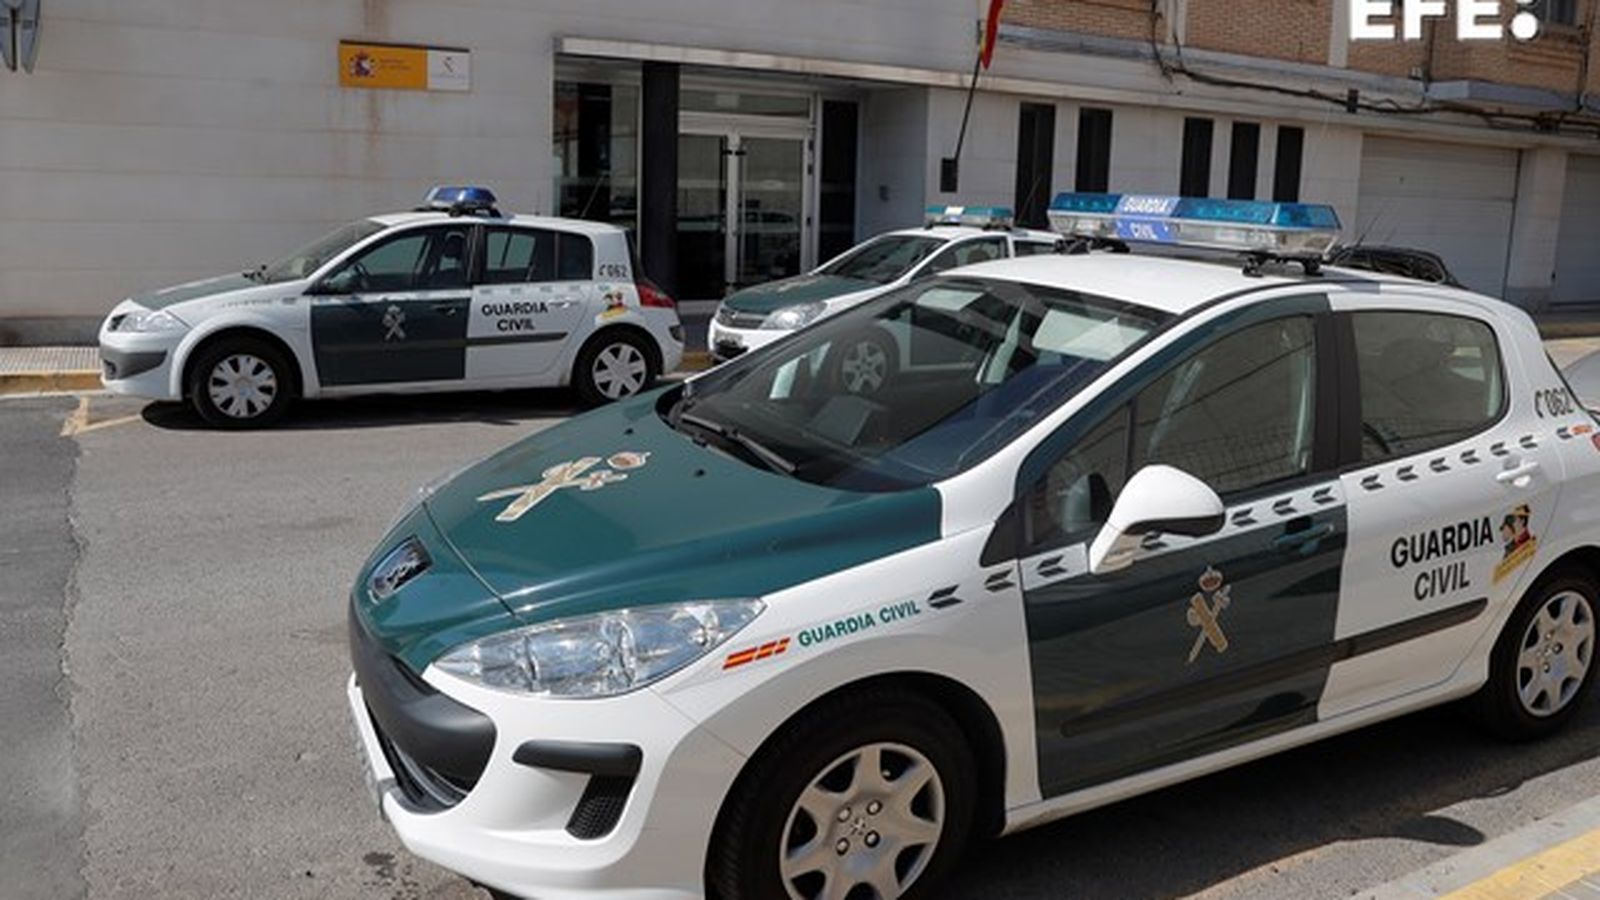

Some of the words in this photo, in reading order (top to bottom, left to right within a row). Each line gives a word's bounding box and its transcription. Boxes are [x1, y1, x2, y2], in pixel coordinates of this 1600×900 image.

[482, 301, 548, 316] GUARDIA
[497, 318, 535, 332] CIVIL
[1391, 516, 1494, 568] GUARDIA
[1414, 561, 1470, 600] CIVIL
[798, 613, 876, 647] GUARDIA
[879, 600, 921, 624] CIVIL
